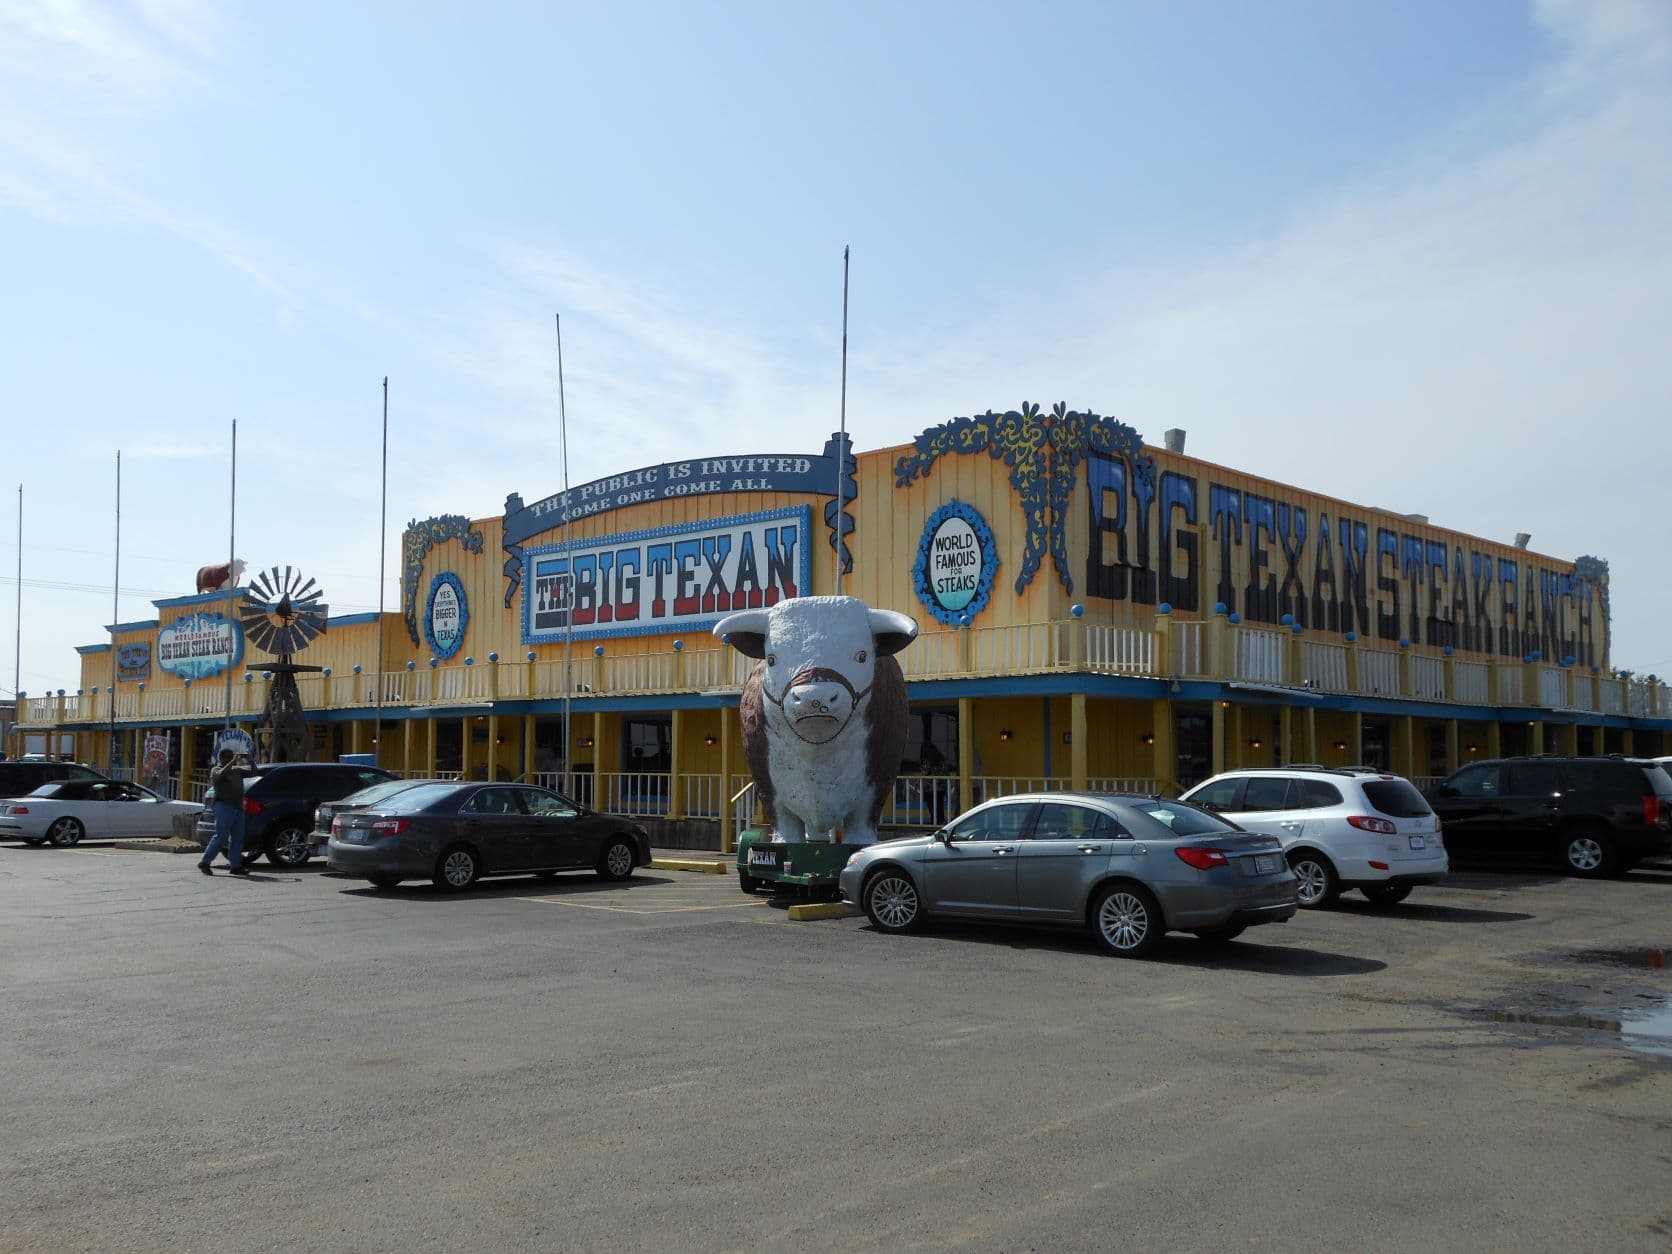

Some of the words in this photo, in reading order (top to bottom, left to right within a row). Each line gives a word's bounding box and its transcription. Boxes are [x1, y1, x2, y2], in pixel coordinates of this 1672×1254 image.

[530, 492, 573, 518] THE
[580, 469, 657, 500] PUBLIC
[668, 463, 691, 480] IS
[700, 457, 812, 474] INVITED
[561, 498, 611, 521] COME
[617, 489, 656, 505] ONE
[664, 480, 721, 497] COME
[730, 478, 773, 490] ALL
[936, 533, 973, 552] WORLD
[1086, 450, 1198, 612] BIG
[1209, 482, 1368, 636] TEXAN
[1376, 526, 1493, 654] STEAK
[936, 551, 976, 570] FAMOUS
[572, 547, 640, 625] BIG
[647, 525, 798, 617] TEXAN
[951, 567, 962, 576] FOR
[937, 574, 976, 594] STEAKS
[440, 590, 451, 599] YES
[435, 607, 457, 620] BIGGER
[437, 628, 455, 641] TEXAS
[191, 638, 211, 657] STEAK
